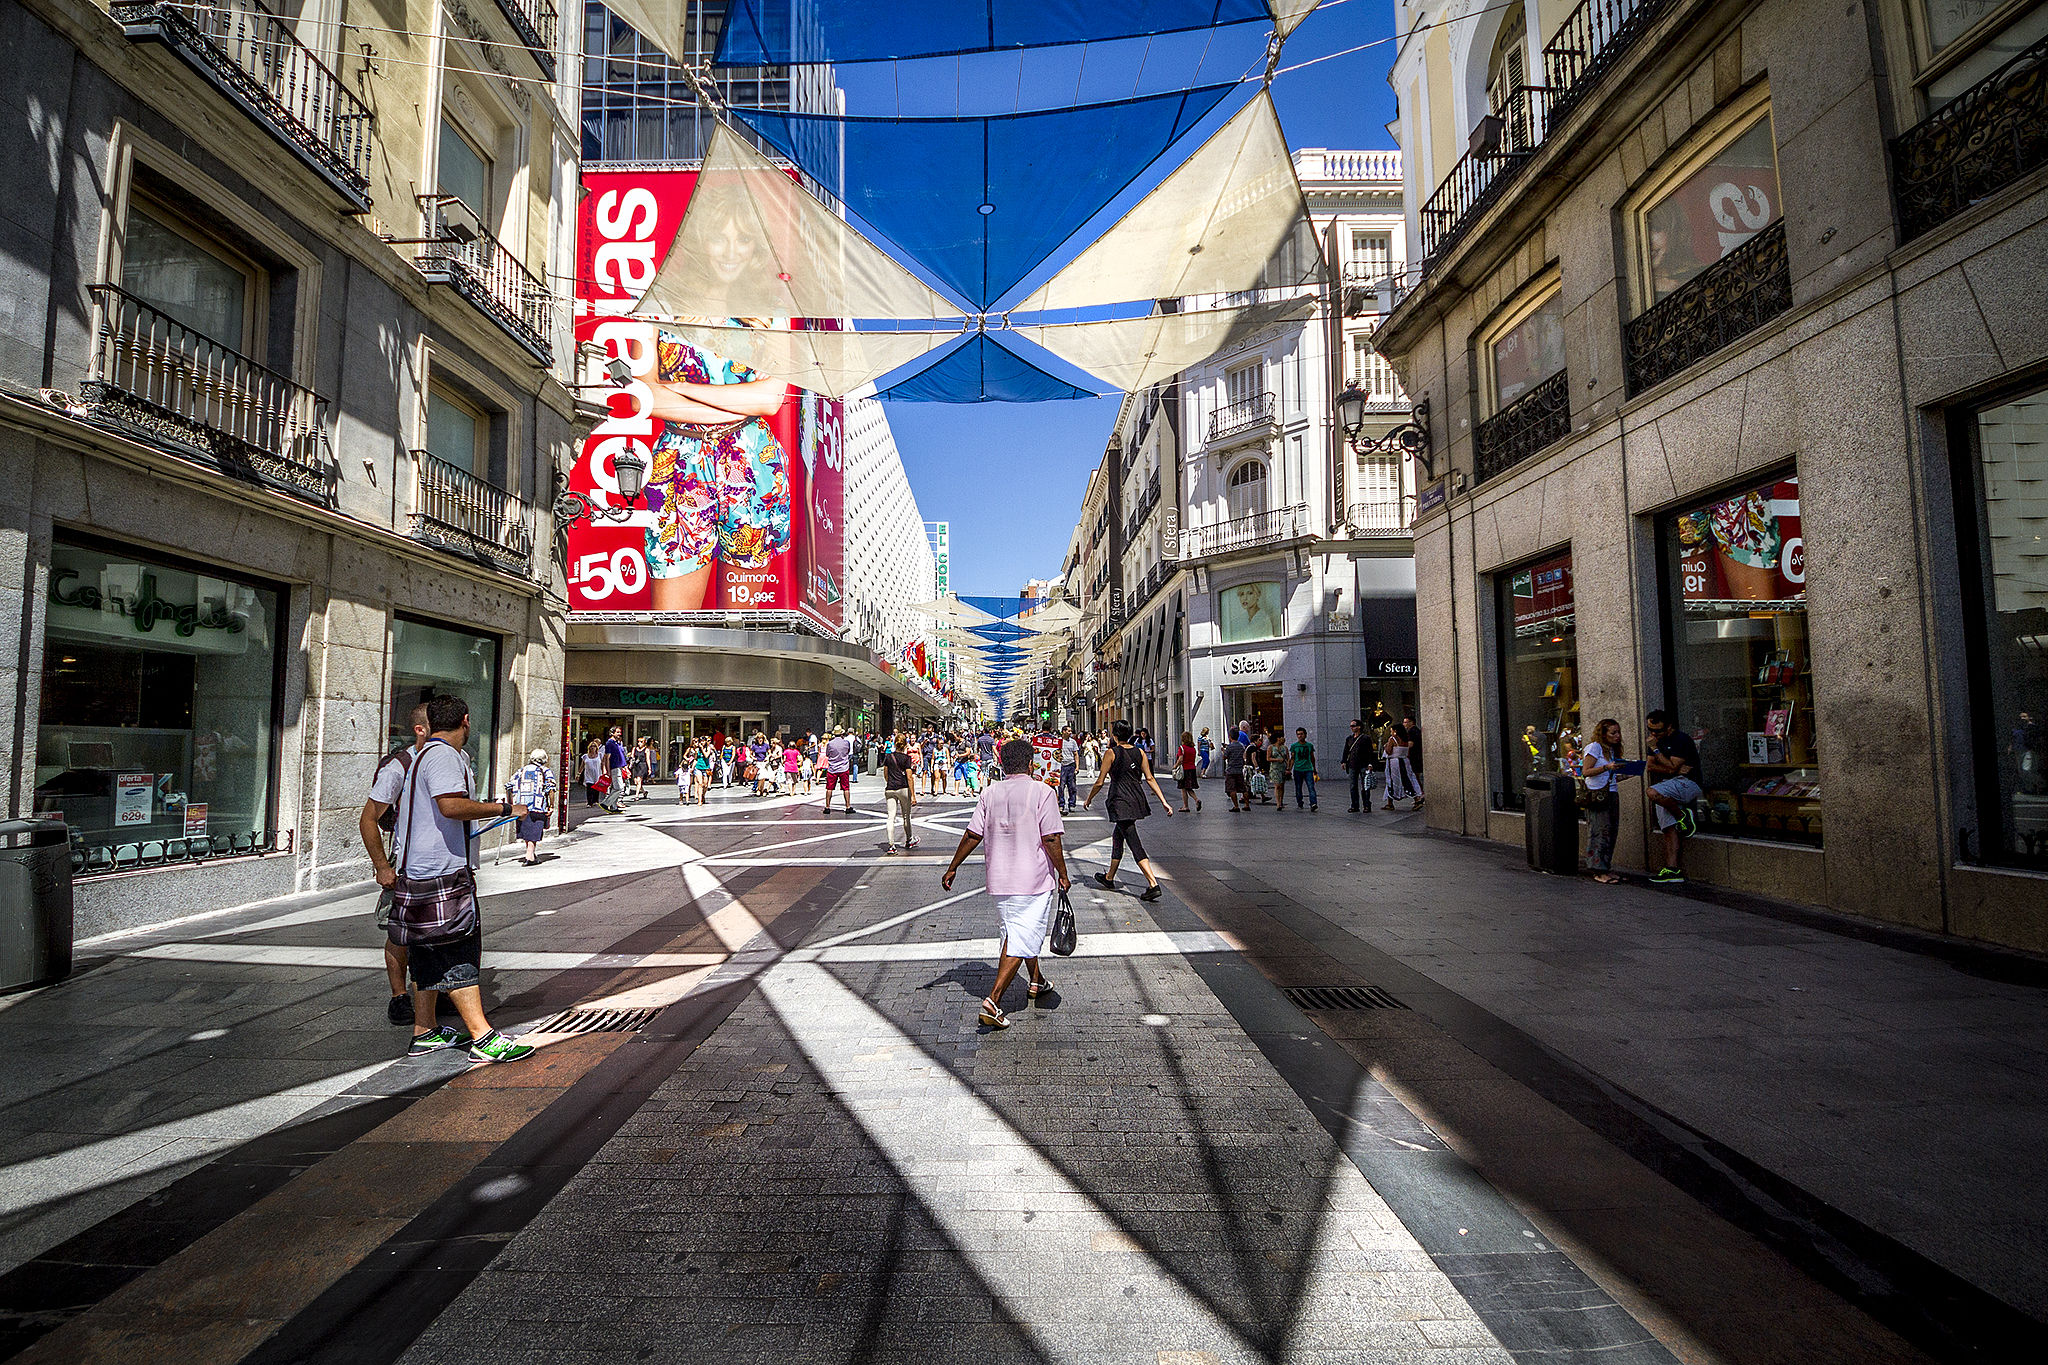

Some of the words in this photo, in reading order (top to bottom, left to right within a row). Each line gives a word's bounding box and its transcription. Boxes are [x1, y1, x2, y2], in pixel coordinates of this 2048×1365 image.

[938, 524, 947, 546] EL
[726, 571, 779, 585] Quimono,
[938, 552, 948, 599] CORT
[727, 585, 776, 606] 19,99€
[620, 689, 635, 704] El
[636, 691, 669, 705] Corte
[121, 812, 146, 822] 629€
